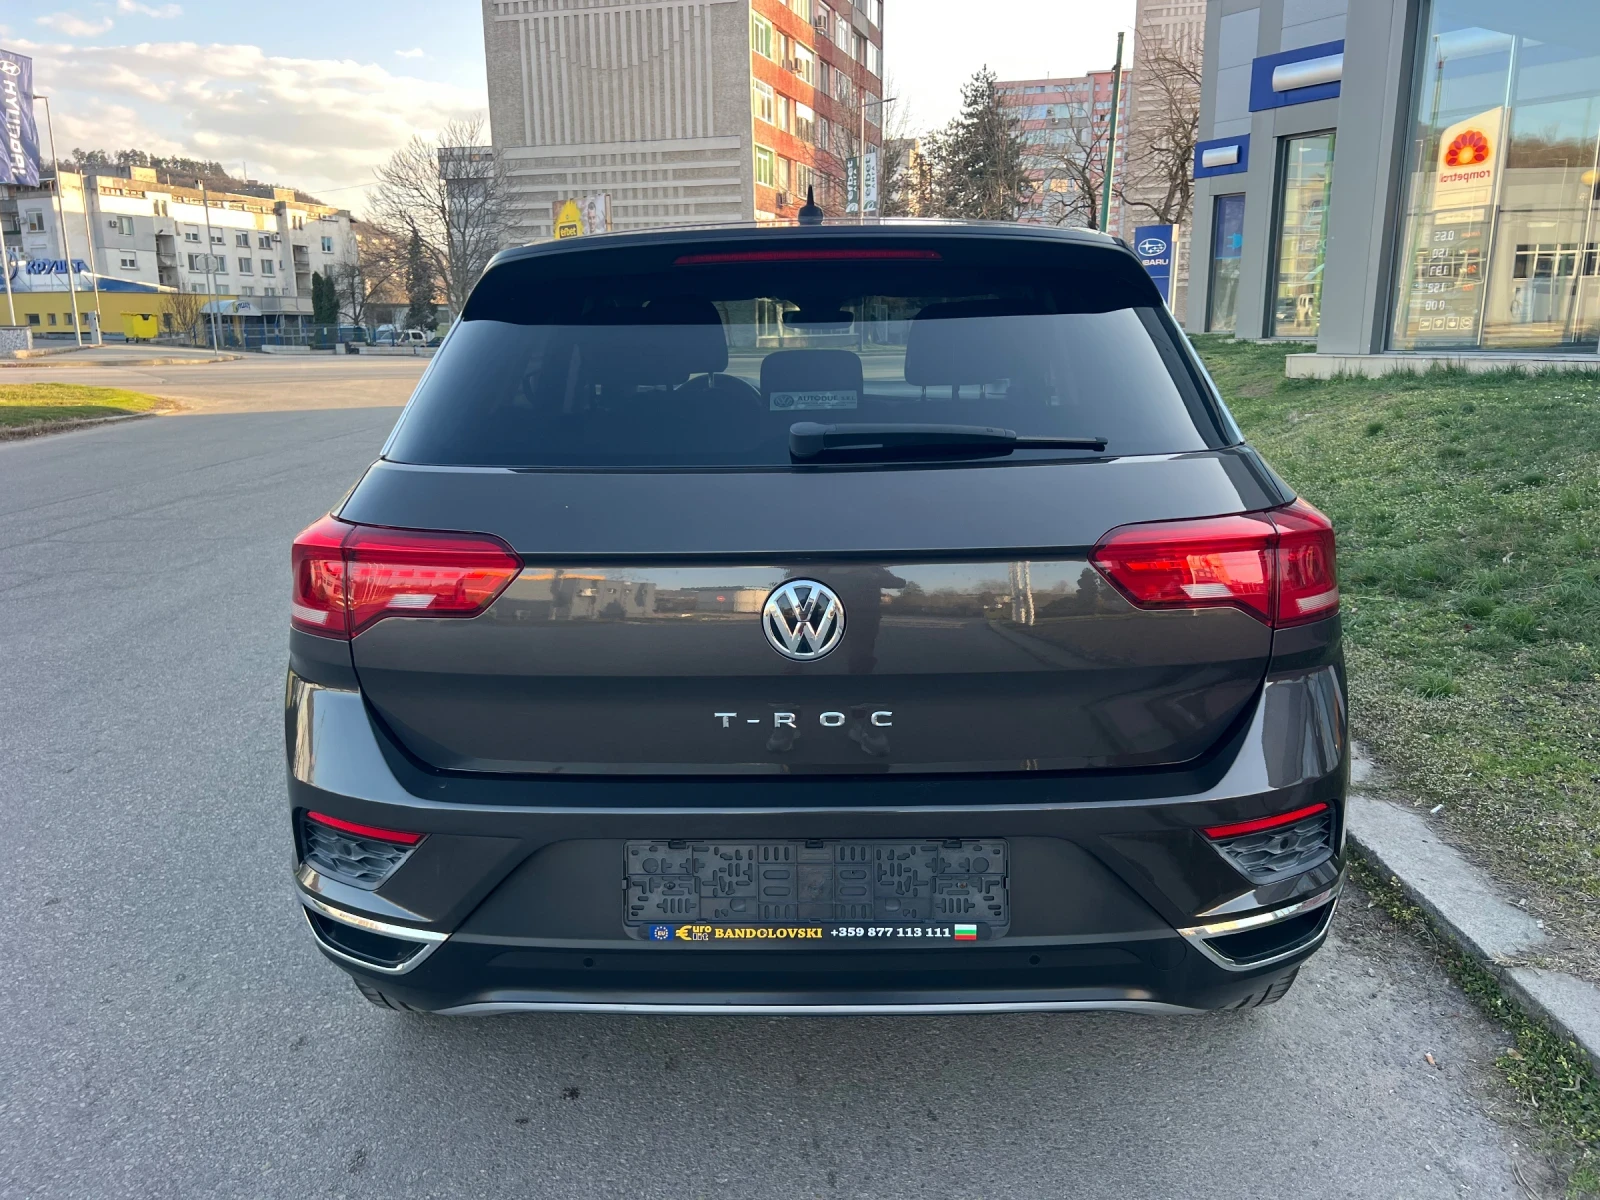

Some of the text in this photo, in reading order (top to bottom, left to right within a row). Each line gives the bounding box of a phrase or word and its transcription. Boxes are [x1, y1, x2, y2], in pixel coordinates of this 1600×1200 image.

[1142, 258, 1169, 266] BARU
[714, 711, 893, 728] T-ROC
[715, 927, 823, 939] BANDOLOVSKI
[830, 927, 864, 937] +359
[867, 927, 893, 937] 877
[896, 927, 922, 937] 113
[925, 927, 951, 937] 111
